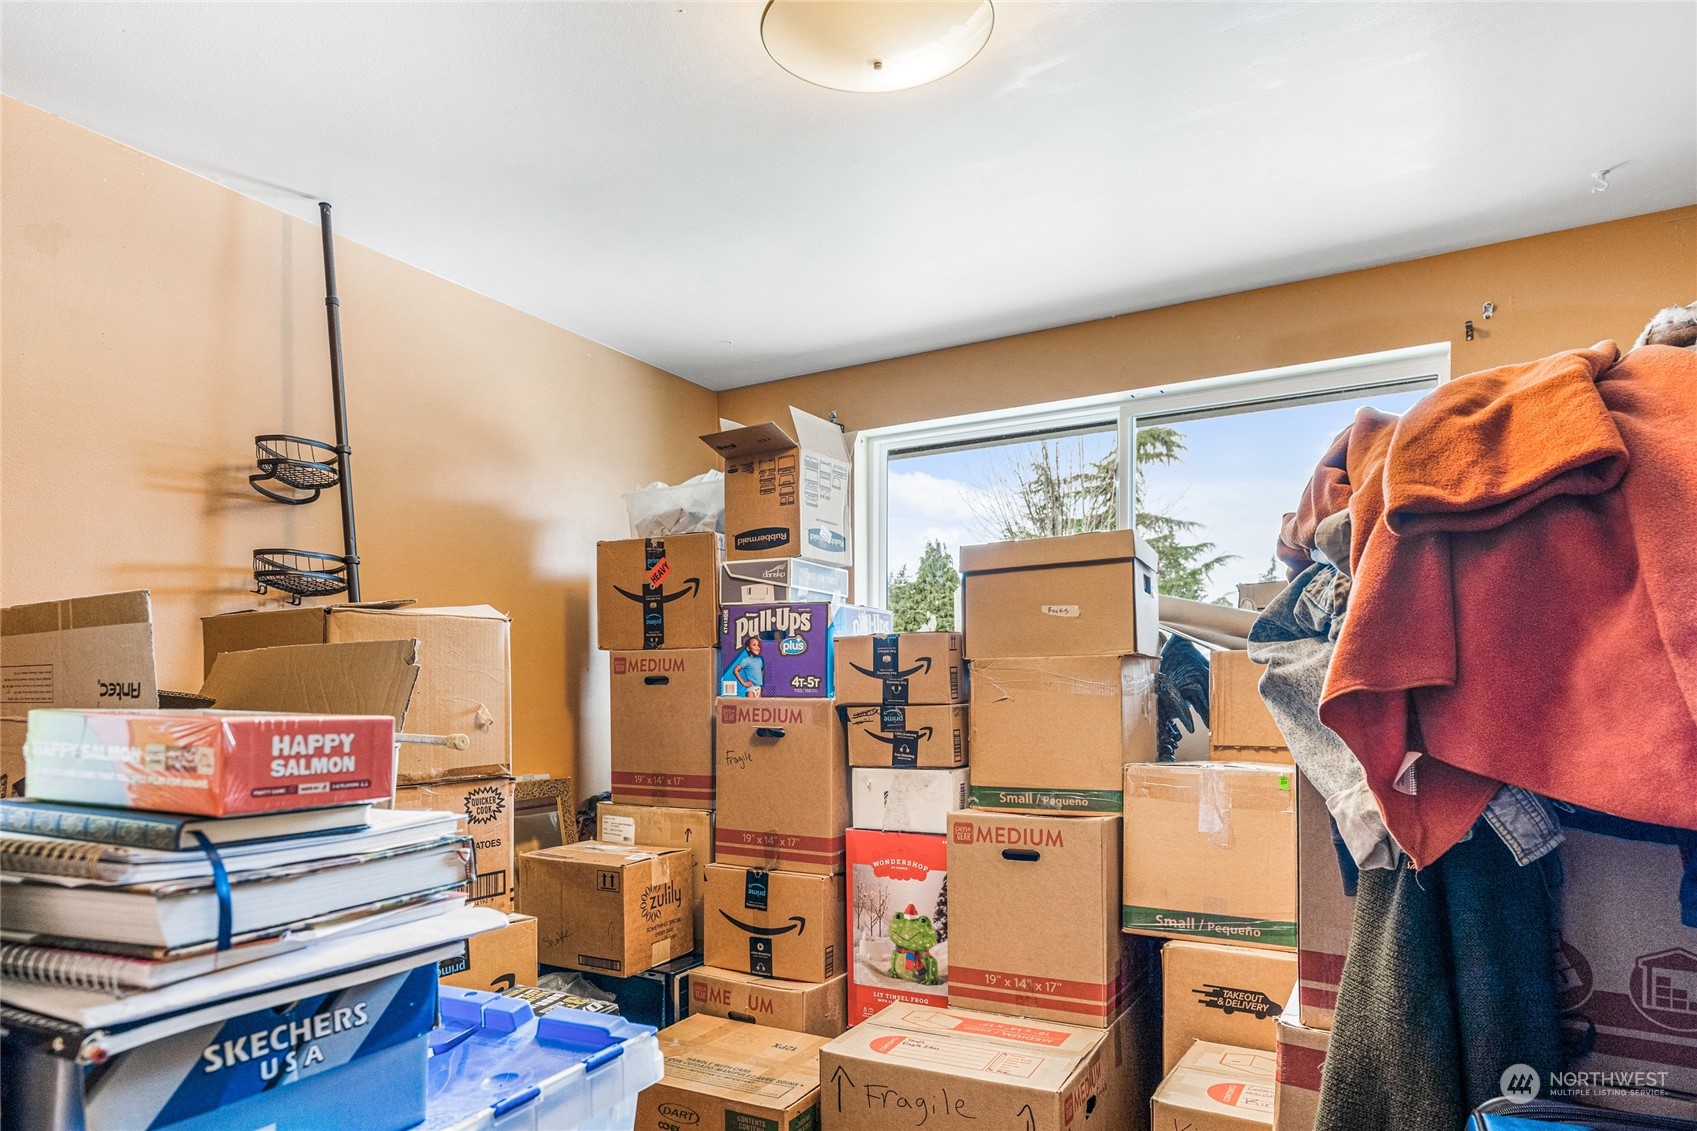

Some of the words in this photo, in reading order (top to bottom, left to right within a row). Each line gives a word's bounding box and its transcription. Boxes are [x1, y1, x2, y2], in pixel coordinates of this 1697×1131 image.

[736, 531, 787, 545] Rubbermaid
[650, 561, 670, 584] HEAVY
[782, 639, 805, 656] plus
[627, 657, 685, 673] MEDIUM
[791, 676, 820, 688] 4T-5T
[99, 681, 141, 701] Antec
[737, 707, 803, 724] MEDIUM
[271, 733, 356, 757] HAPPY
[270, 755, 356, 778] SALMON
[726, 750, 753, 769] Fragile
[471, 796, 497, 806] QUICKER
[999, 792, 1033, 804] Small
[476, 805, 492, 815] COOK
[476, 838, 501, 850] ATOES
[956, 832, 971, 841] GEAR
[976, 825, 1064, 848] MEDIUM
[872, 859, 929, 871] WONDERSHOP
[650, 879, 682, 908] zulily
[747, 888, 766, 897] prime
[1155, 914, 1195, 930] Small
[1207, 922, 1261, 938] Pequeño
[1004, 979, 1011, 987] x
[1035, 983, 1042, 992] x
[709, 987, 774, 1015] MEUM
[885, 993, 909, 1001] TINSEL
[910, 997, 929, 1005] FROG
[1223, 989, 1264, 1003] TAKEOUT
[1217, 997, 1224, 1006] &
[1225, 998, 1269, 1012] DELIVERY
[202, 1002, 369, 1074] SKECHERS
[1001, 1031, 1053, 1043] MEDIUM
[864, 1083, 977, 1127] Fragile
[663, 1105, 695, 1122] DART
[736, 1115, 766, 1129] CONTENTS
